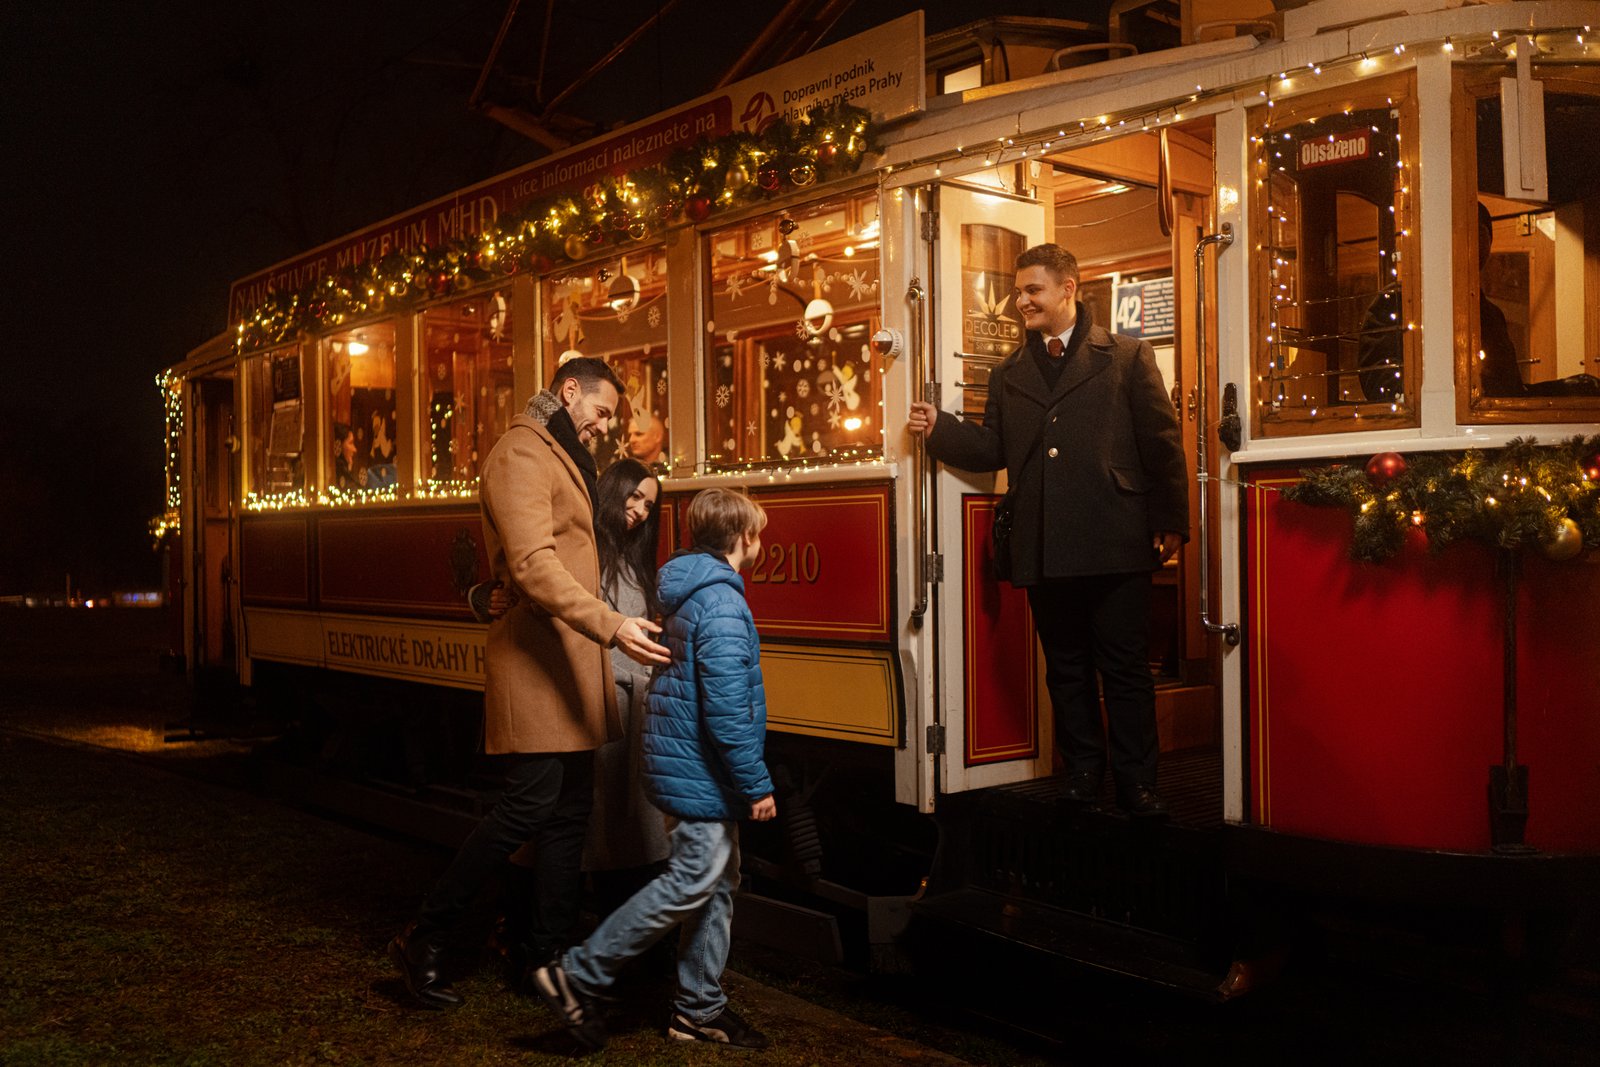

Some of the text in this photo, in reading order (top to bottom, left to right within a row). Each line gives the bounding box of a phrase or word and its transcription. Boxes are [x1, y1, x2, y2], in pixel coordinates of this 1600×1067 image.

[783, 58, 875, 104] Dopravní podnik
[833, 83, 866, 105] města
[869, 71, 903, 94] Prahy
[543, 146, 608, 188] informací
[613, 123, 689, 164] naleznete
[695, 112, 717, 134] na
[1301, 136, 1366, 165] Obsazeno
[965, 318, 1020, 338] DECOLED
[1116, 295, 1142, 329] 42
[751, 542, 819, 583] 2210
[328, 631, 409, 665] ELEKTRICKÉ
[412, 637, 469, 672] DRÁHY
